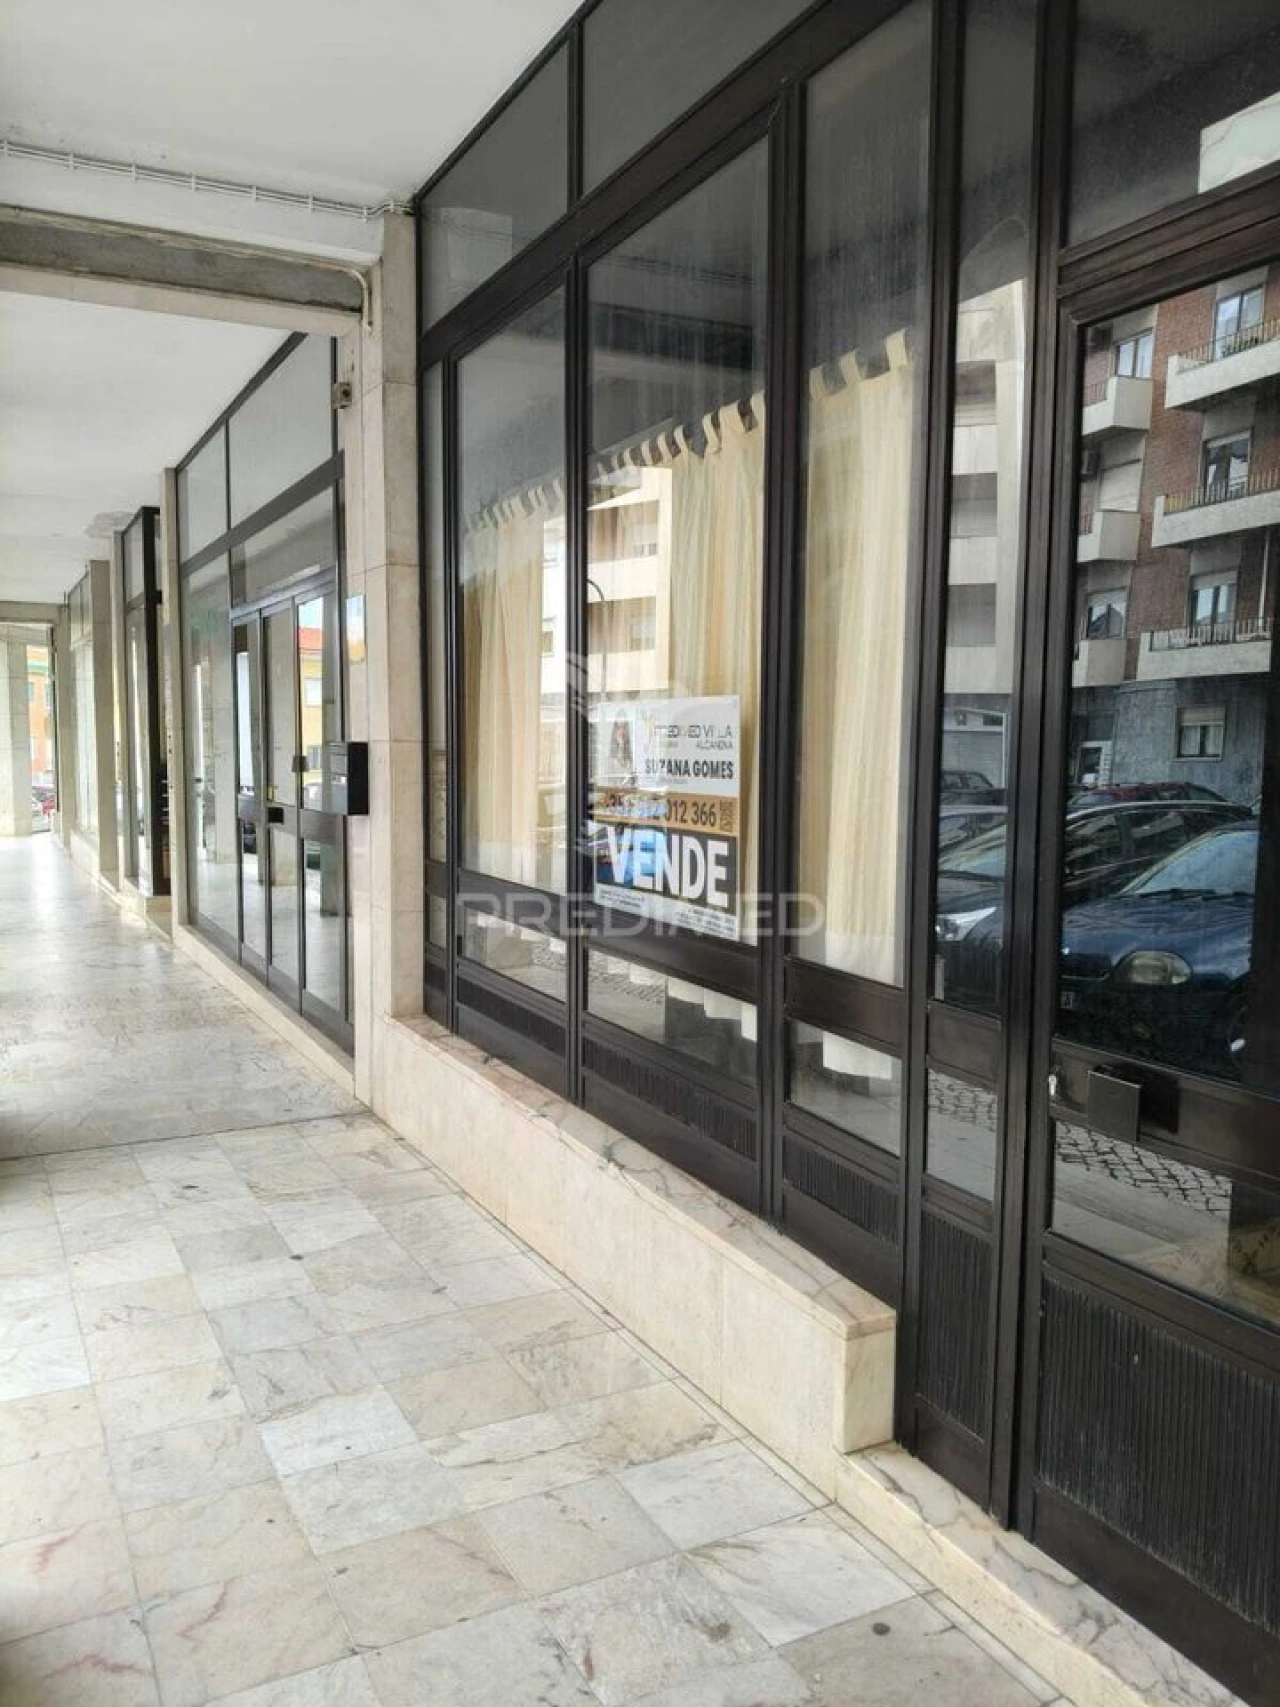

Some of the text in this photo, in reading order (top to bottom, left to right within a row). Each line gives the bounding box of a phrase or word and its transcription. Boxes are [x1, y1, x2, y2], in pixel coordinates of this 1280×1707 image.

[693, 759, 734, 780] GOMES
[691, 801, 717, 828] 366
[607, 826, 728, 908] VENDE
